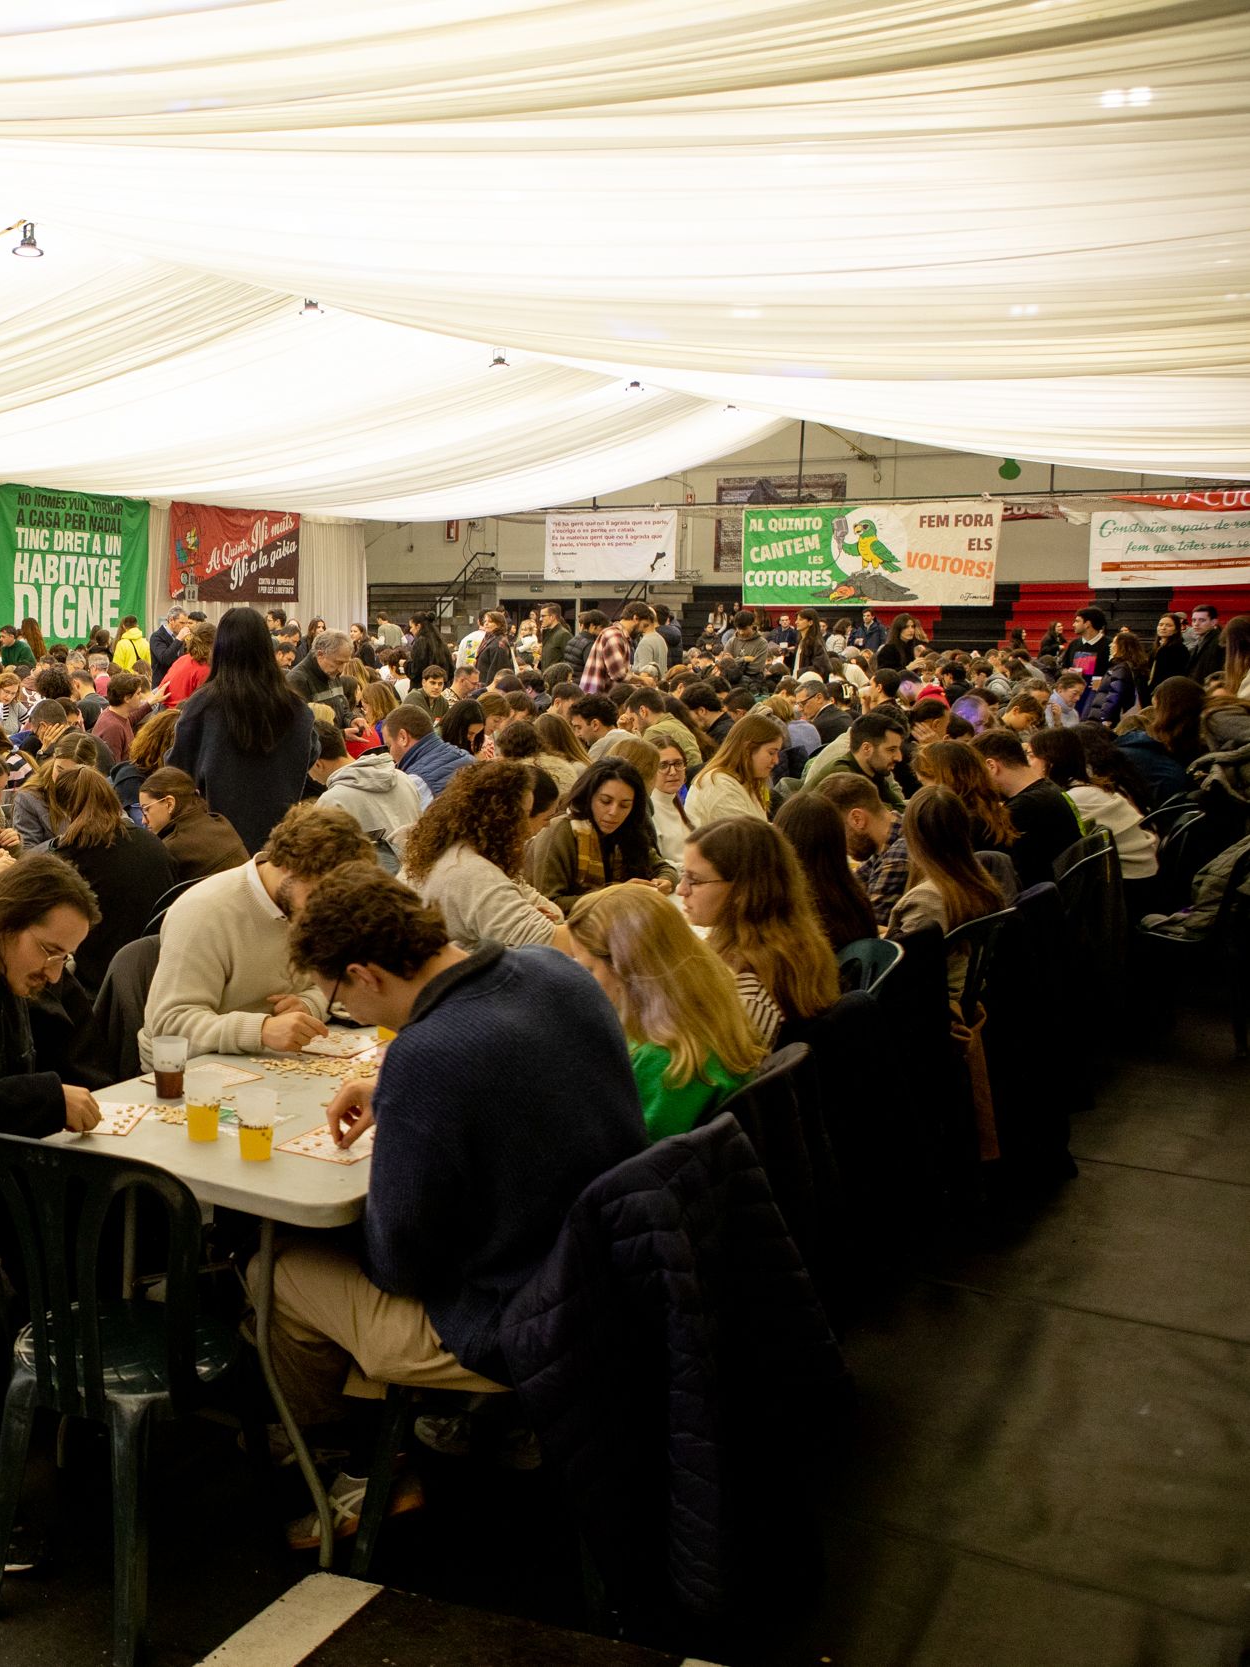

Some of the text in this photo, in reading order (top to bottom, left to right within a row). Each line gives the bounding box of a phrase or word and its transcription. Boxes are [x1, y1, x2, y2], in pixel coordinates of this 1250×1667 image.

[17, 491, 124, 516] NO NOMÉS VULL TORNAR
[16, 508, 122, 534] A CASA PER NADAL
[251, 516, 269, 554] Ni
[271, 513, 295, 538] muts
[748, 516, 823, 533] AL QUINTO
[919, 513, 994, 529] FEM FORA
[1099, 518, 1167, 538] Construïm
[1171, 521, 1209, 535] espais
[1213, 519, 1231, 530] de
[15, 527, 122, 557] TINC DRET A UN
[749, 534, 821, 564] CANTEM
[967, 537, 993, 551] ELS
[1125, 541, 1150, 555] fem
[1153, 543, 1176, 554] que
[1177, 540, 1207, 552] totes
[1210, 541, 1233, 550] ens
[14, 552, 121, 588] HABITATGE
[230, 540, 298, 591] Ni a la gàbia
[807, 555, 824, 565] LES
[906, 551, 995, 580] VOLTORS!
[744, 569, 838, 590] COTORRES,
[14, 583, 121, 639] DIGNE
